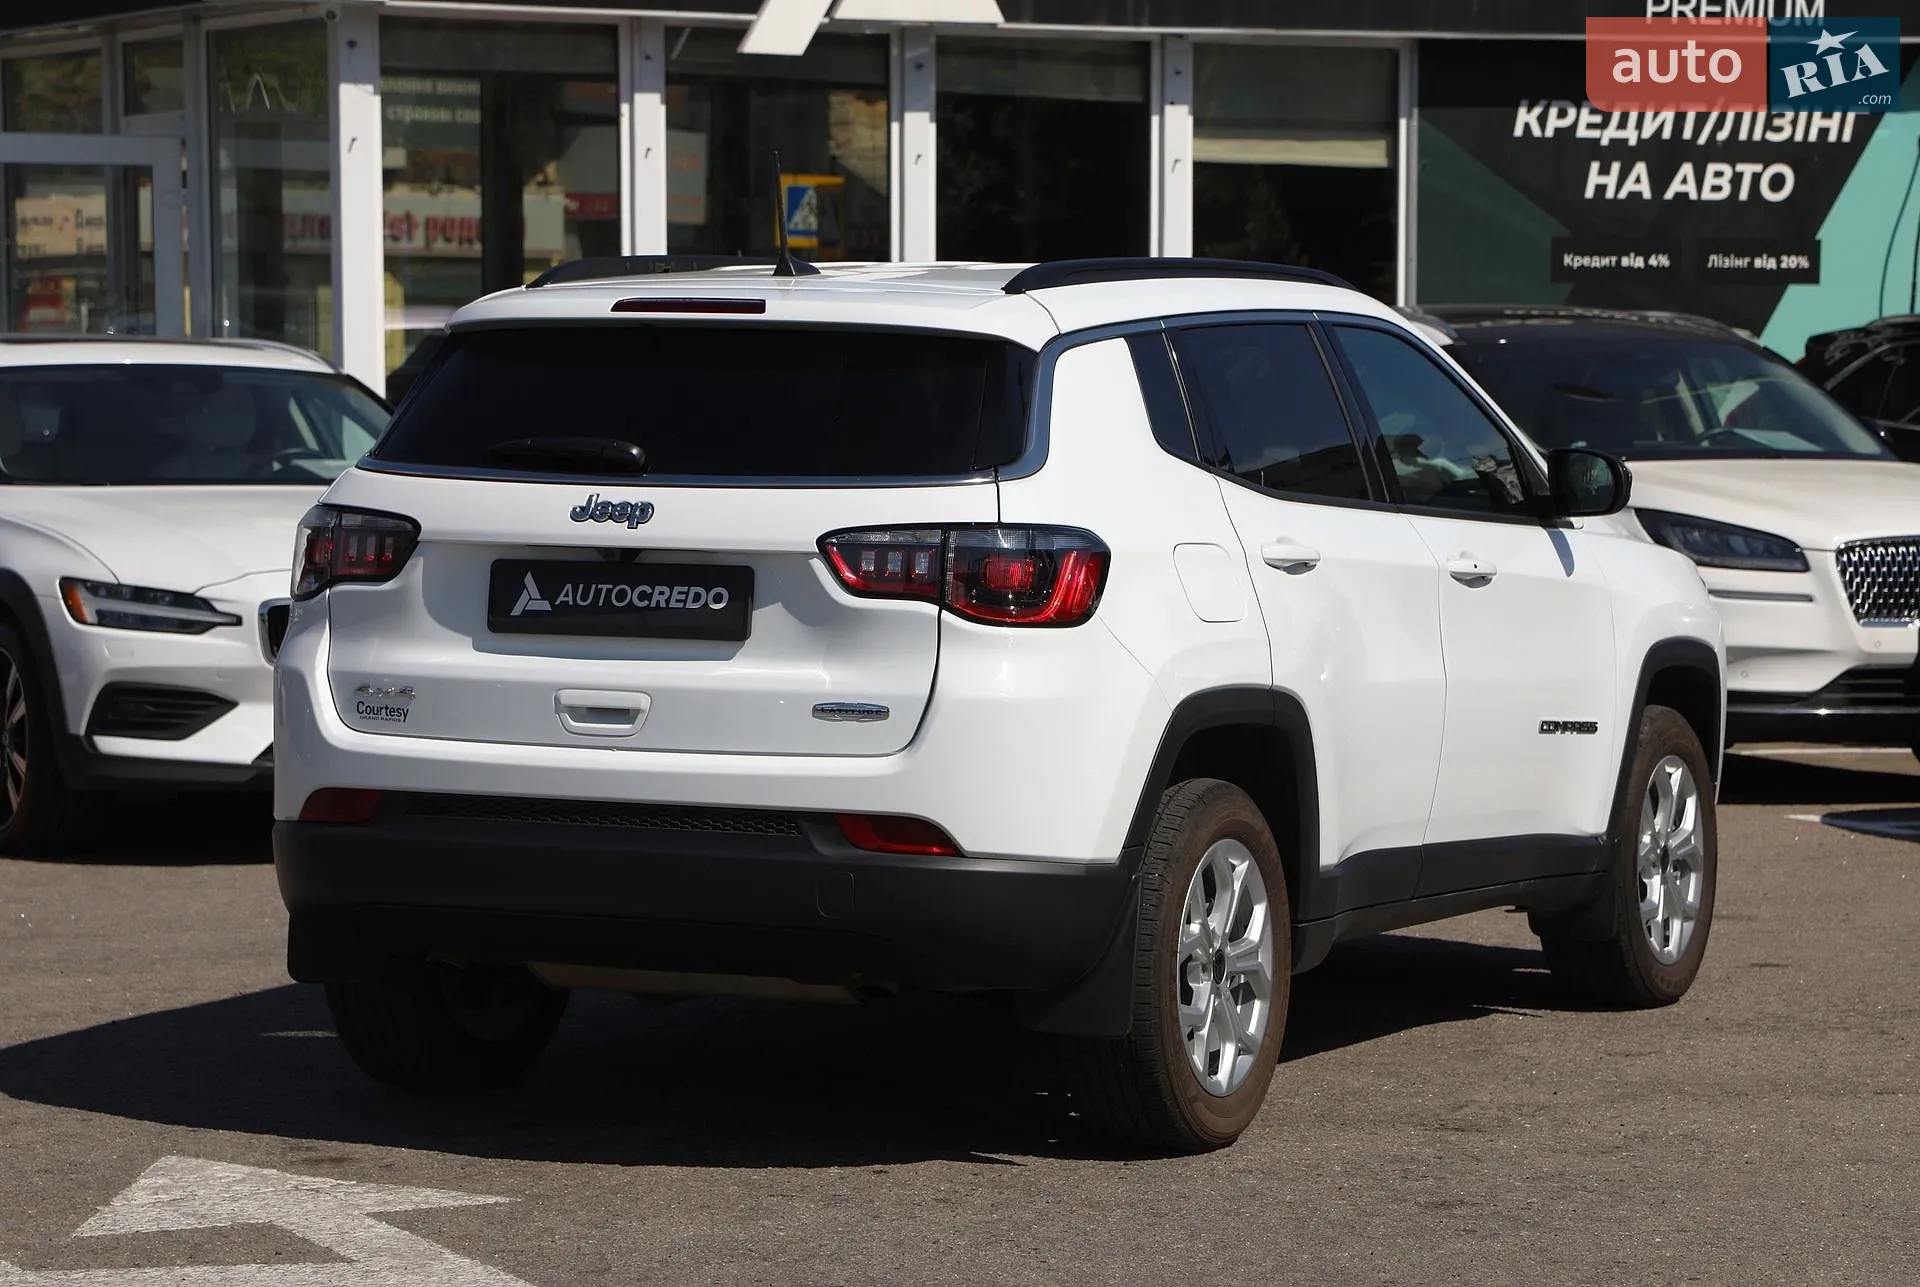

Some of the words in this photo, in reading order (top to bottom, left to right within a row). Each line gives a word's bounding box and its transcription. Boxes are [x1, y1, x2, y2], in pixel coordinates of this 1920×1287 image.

[1645, 0, 1825, 26] PREMIUM
[1584, 160, 1653, 200] НА
[1663, 161, 1796, 203] АВТО
[1563, 252, 1618, 270] Кредит
[1620, 252, 1645, 269] від
[1648, 253, 1670, 268] 4%
[1707, 253, 1751, 269] Лізінг
[1753, 253, 1777, 270] від
[1780, 254, 1809, 269] 20%
[570, 493, 655, 529] Jeep
[555, 583, 729, 610] AUTOCREDO
[356, 700, 409, 722] Courtesy
[1539, 720, 1598, 734] COMPASS
